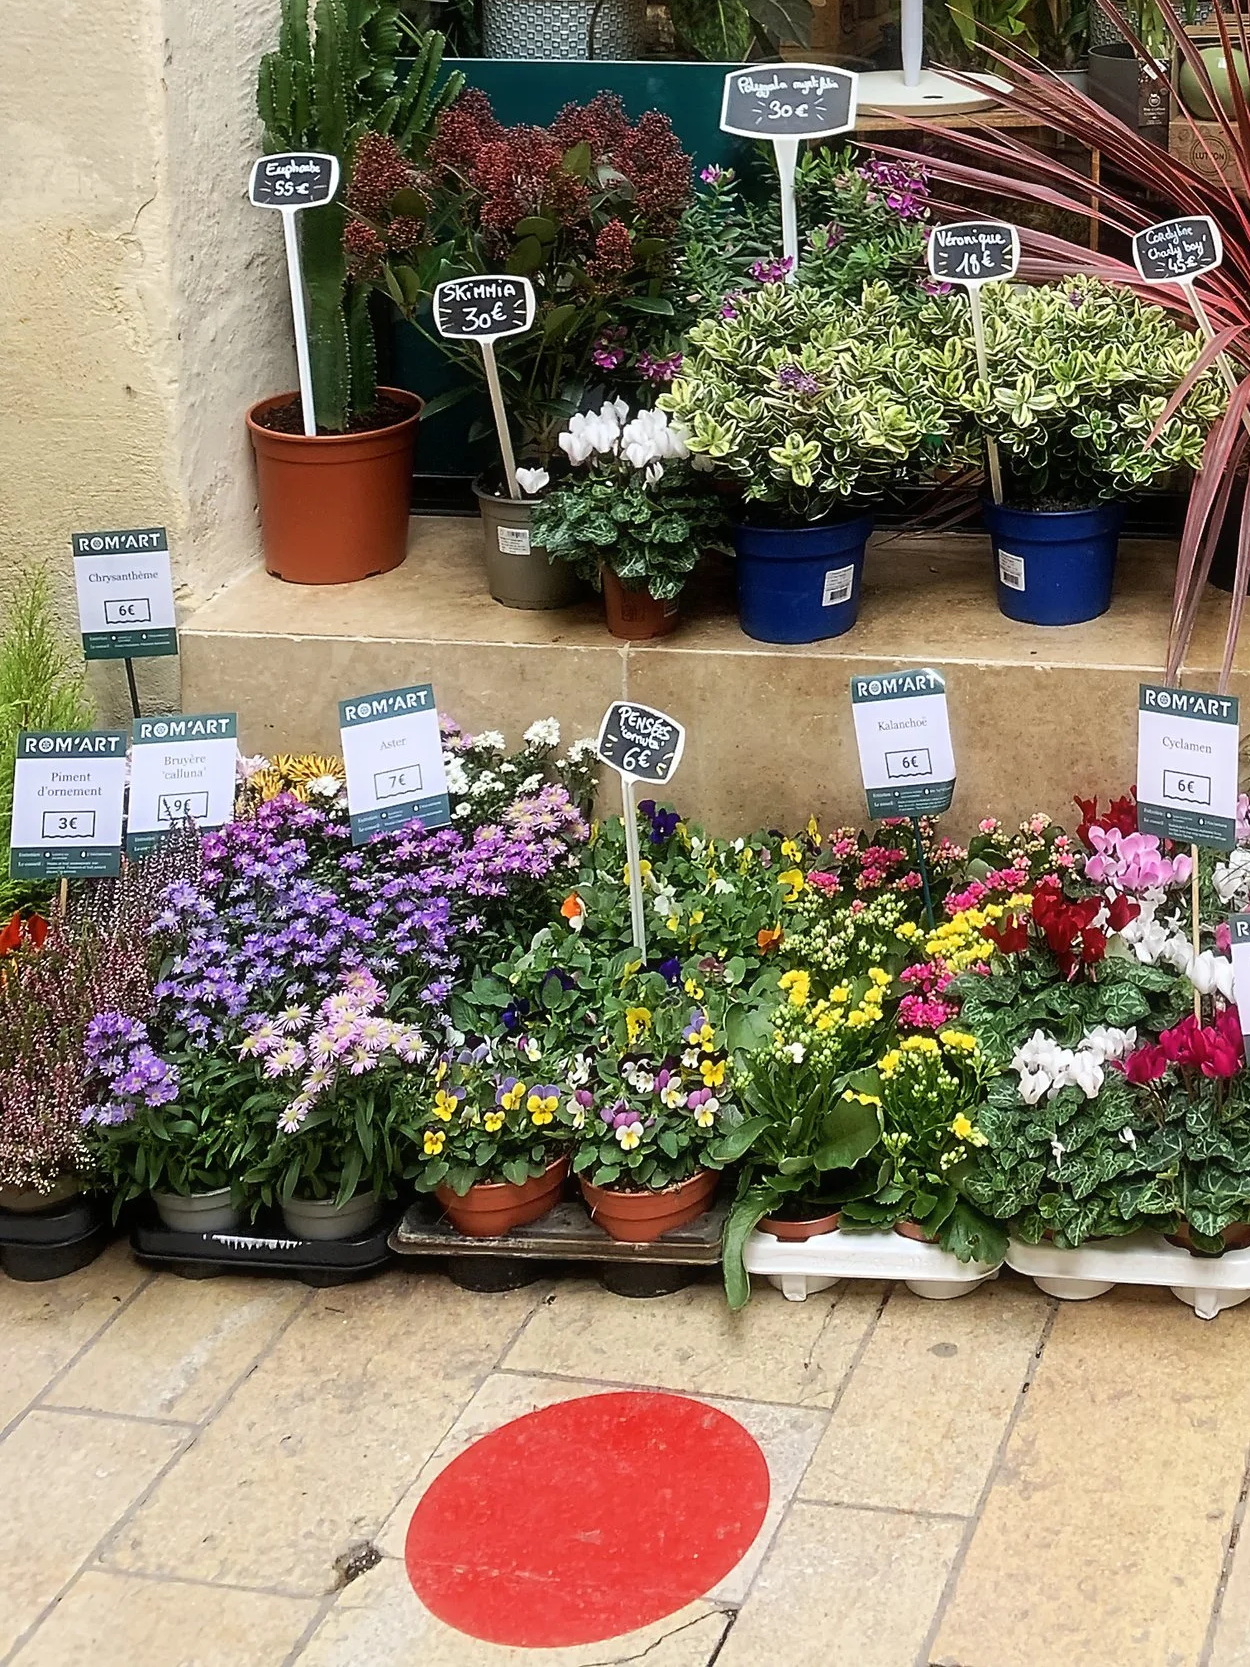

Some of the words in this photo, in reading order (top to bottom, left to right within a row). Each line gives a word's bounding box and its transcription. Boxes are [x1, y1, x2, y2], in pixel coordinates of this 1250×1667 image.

[768, 100, 809, 120] 30€
[273, 180, 310, 197] 55€
[936, 228, 1007, 252] Véronique
[955, 249, 996, 276] 18€
[1167, 255, 1199, 274] 45€
[461, 301, 508, 332] 30€
[79, 532, 161, 552] ROM'ART
[88, 570, 159, 584] Chrysanthème
[118, 603, 135, 617] 6€
[856, 674, 938, 697] ROM'ART
[345, 690, 428, 721] ROM'ART
[1144, 688, 1232, 718] ROM'ART
[140, 718, 230, 739] ROM'ART
[877, 715, 928, 732] Kalanchoë
[25, 736, 120, 754] ROM'ART
[379, 736, 408, 752] Aster
[1162, 735, 1213, 754] Cyclamen
[163, 753, 207, 768] Bruyère
[622, 746, 652, 771] 6€
[902, 755, 919, 769] 6€
[51, 771, 92, 783] Piment
[388, 773, 407, 789] 7€
[37, 785, 103, 798] d'ornement
[1177, 778, 1196, 794] 6€
[173, 798, 192, 813] 9€
[58, 817, 78, 830] 3€
